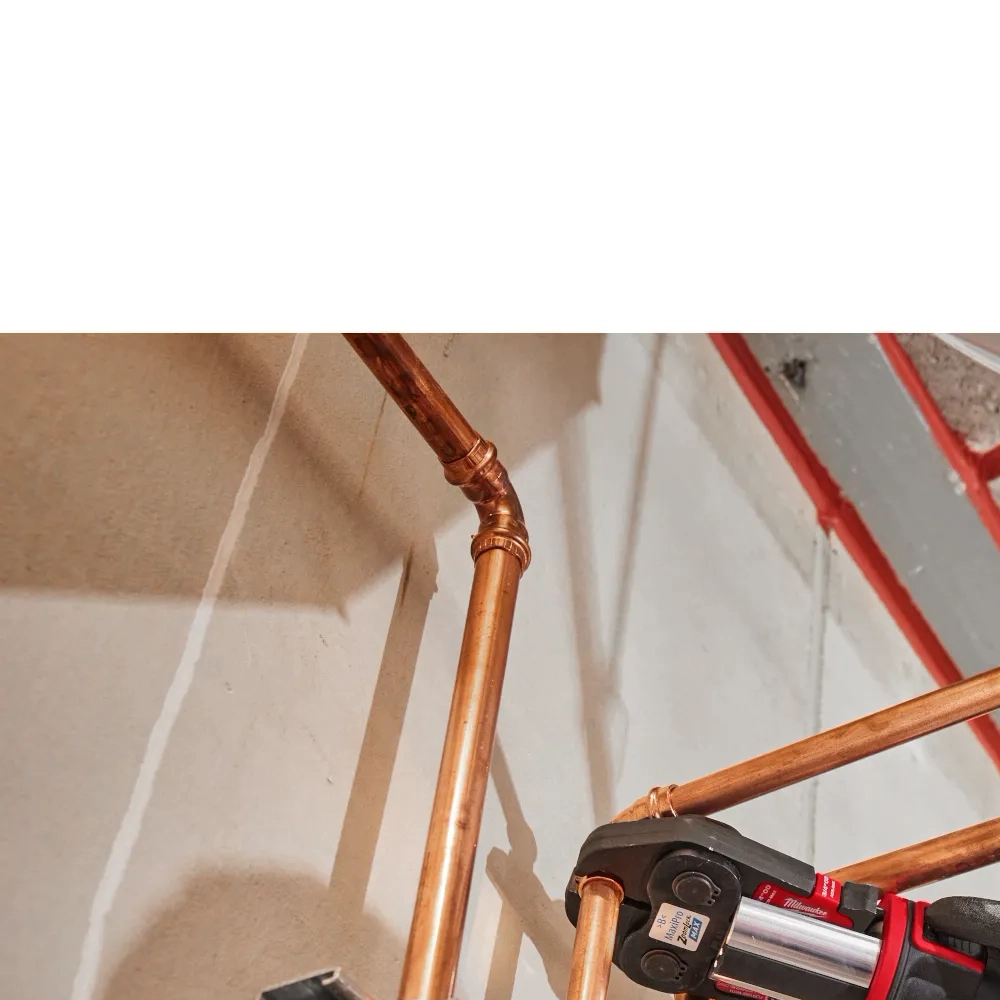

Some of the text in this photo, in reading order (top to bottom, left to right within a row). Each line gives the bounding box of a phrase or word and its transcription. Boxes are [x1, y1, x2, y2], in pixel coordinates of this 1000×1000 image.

[784, 897, 828, 916] Milwaukee
[664, 910, 684, 941] MaxiPro
[690, 921, 701, 940] MAX
